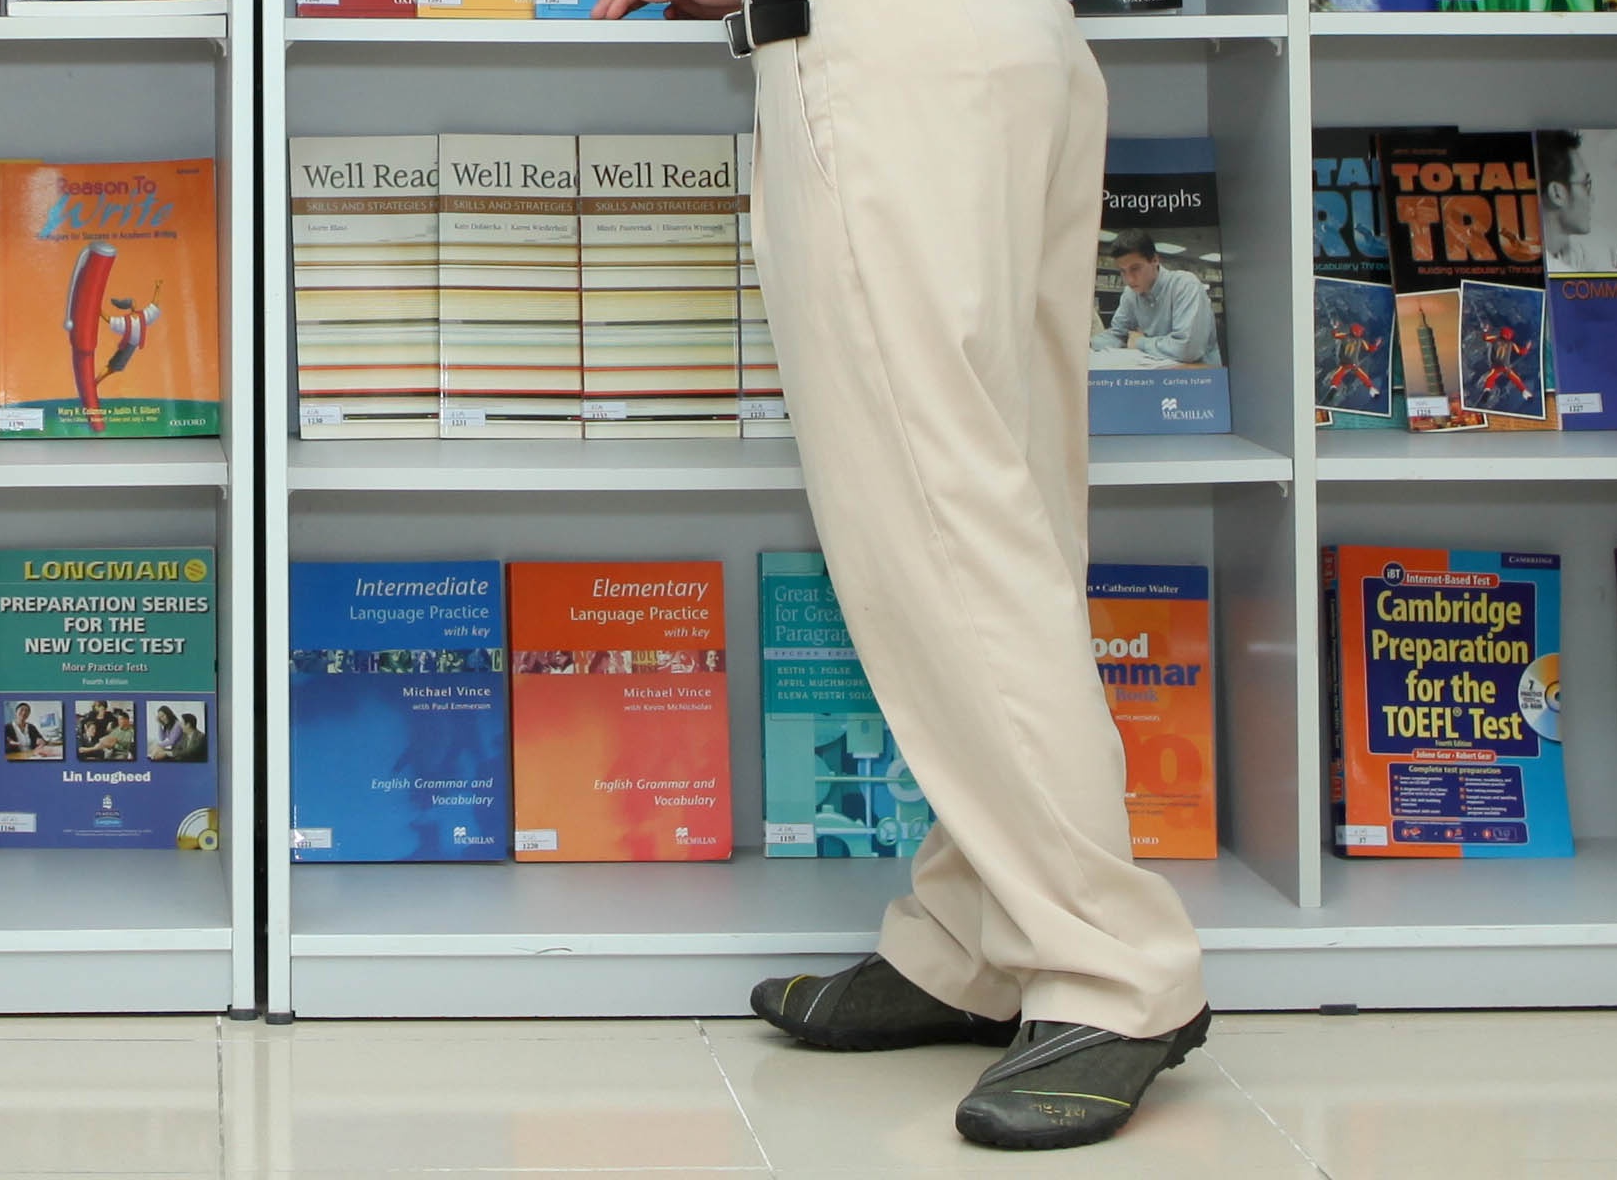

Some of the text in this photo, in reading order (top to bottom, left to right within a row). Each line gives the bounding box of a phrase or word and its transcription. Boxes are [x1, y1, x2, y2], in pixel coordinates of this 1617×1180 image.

[593, 162, 731, 189] Well Read
[1391, 162, 1536, 192] TOTAL
[57, 177, 127, 195] Reason
[40, 189, 174, 236] Write
[596, 201, 716, 212] SKILLS AND STRATEGIES
[169, 419, 206, 427] OXFORD
[1163, 410, 1214, 420] MACMILLAN
[23, 561, 180, 582] LONGMAN
[355, 577, 489, 598] Intermediate
[592, 578, 709, 601] Elementary
[775, 586, 821, 603] Great
[1102, 583, 1179, 594] Catherine Walter
[142, 596, 209, 613] SERIES
[1376, 590, 1523, 632] Cambridge
[350, 604, 490, 624] Language Practice
[570, 606, 709, 624] Language Practice
[444, 625, 491, 639] with key
[1372, 629, 1529, 669] Preparation
[402, 685, 491, 698] Michael Vince
[1116, 688, 1158, 702] Book
[1469, 711, 1524, 741] Test
[371, 777, 493, 791] English Grammar and
[432, 795, 494, 808] Vocabulary
[454, 835, 495, 845] MACMILLAN
